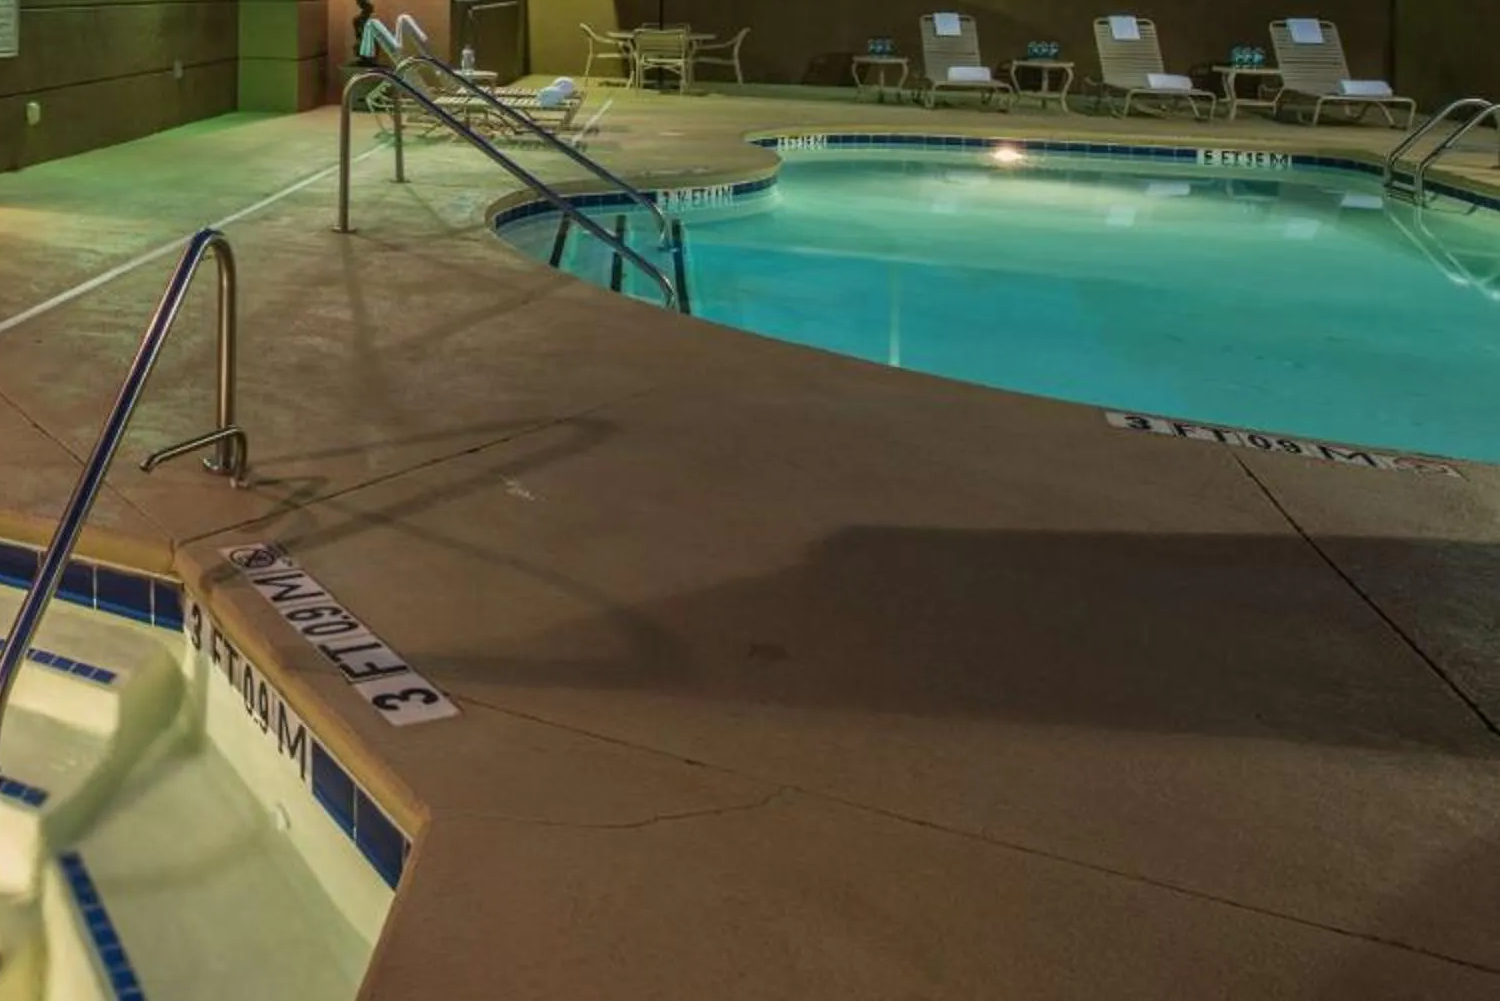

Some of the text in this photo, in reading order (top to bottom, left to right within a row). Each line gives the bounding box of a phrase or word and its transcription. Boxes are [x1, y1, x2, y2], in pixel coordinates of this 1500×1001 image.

[1124, 414, 1151, 430] 3
[1172, 422, 1232, 442] FT
[191, 603, 308, 781] 3 FT 0.9 M
[253, 573, 439, 711] 3 FT 0.9 M
